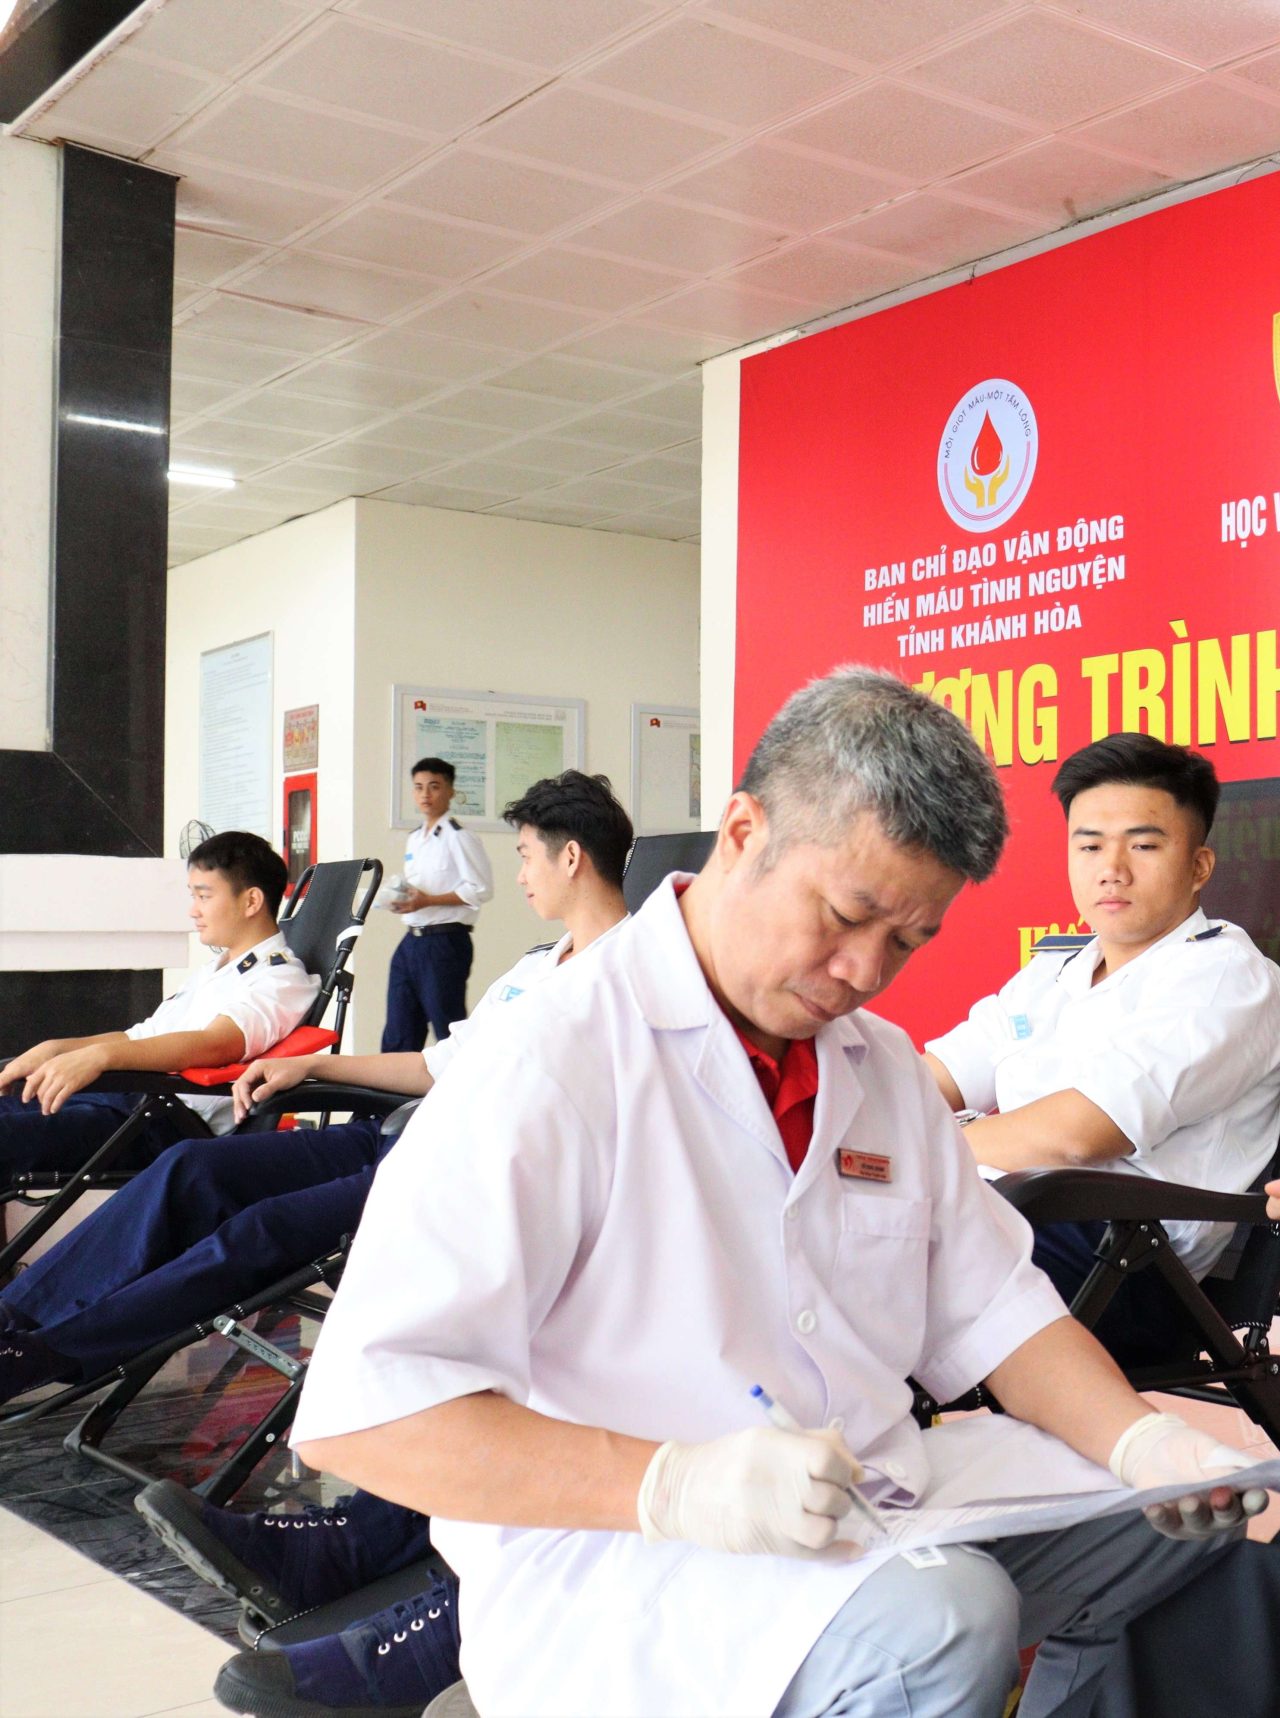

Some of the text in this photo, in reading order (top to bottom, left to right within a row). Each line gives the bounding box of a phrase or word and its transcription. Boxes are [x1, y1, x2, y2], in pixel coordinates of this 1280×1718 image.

[864, 514, 1124, 591] BAN CHỈ ĐẠO VẬN ĐỘNG
[1221, 496, 1267, 548] HỌC
[863, 554, 1125, 627] HIẾN MÁU TÌNH NGUYỆN
[897, 602, 1082, 657] TỈNH KHÁNH HÒA
[912, 663, 1058, 768] ƠNG
